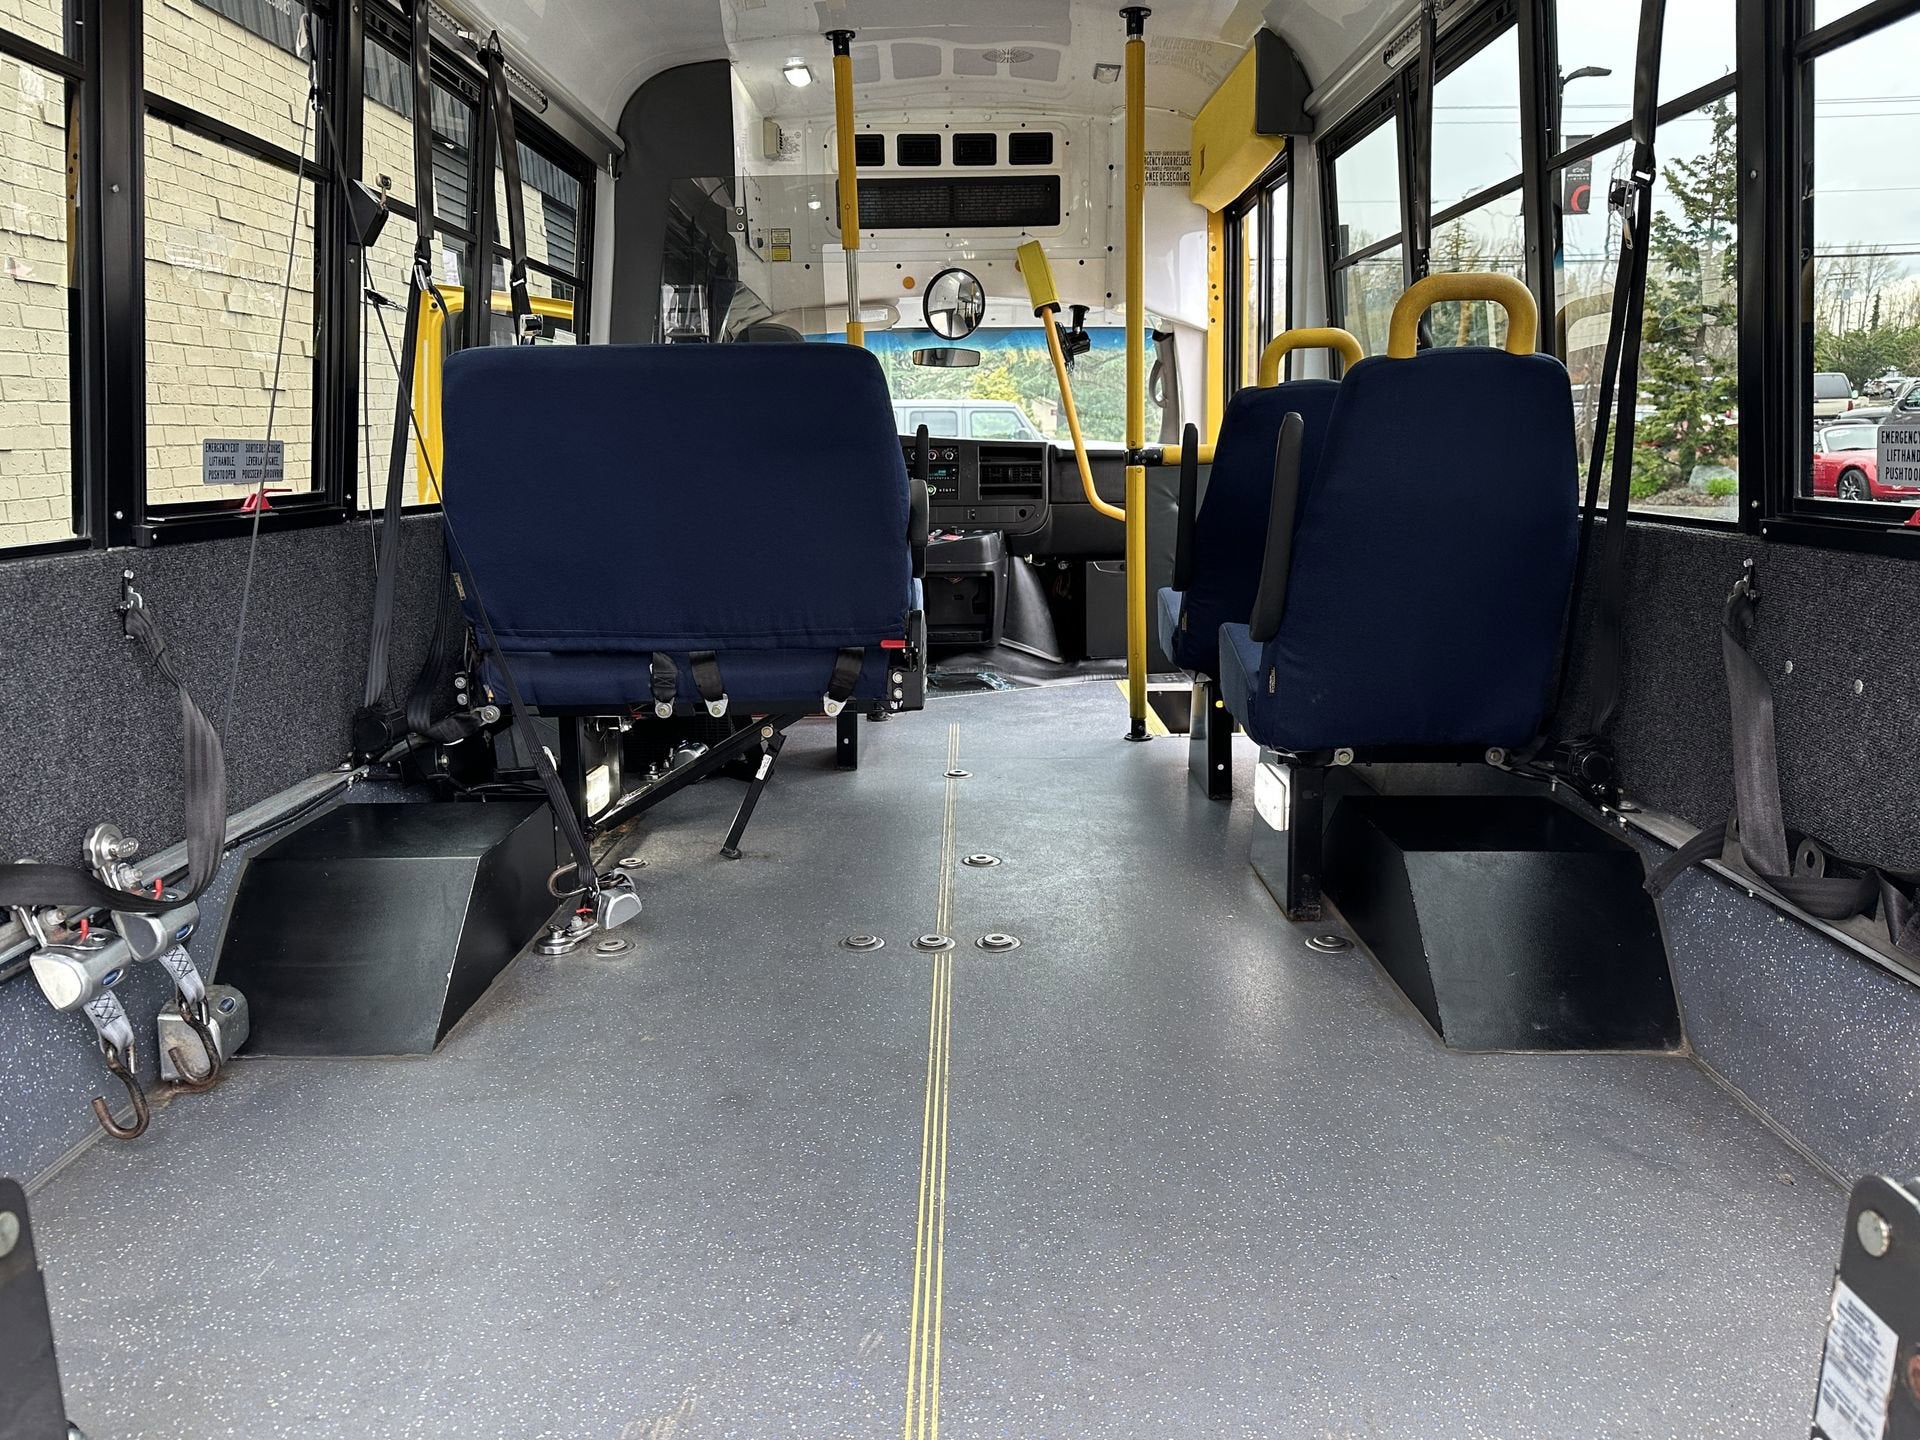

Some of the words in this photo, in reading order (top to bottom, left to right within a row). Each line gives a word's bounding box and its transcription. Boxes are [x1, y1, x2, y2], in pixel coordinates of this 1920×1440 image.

[1166, 171, 1190, 181] SECOURS
[205, 442, 230, 453] EMERGENCY
[230, 442, 240, 453] EXIT
[245, 443, 259, 454] SORTIE
[208, 456, 218, 466] LIFT
[245, 456, 257, 466] LEVER
[1886, 449, 1900, 462] LIFT
[208, 469, 219, 480] PUSH
[225, 469, 236, 480] OPEN
[241, 469, 259, 479] POUSSER
[1885, 466, 1903, 480] PUSH
[1904, 467, 1912, 481] TO
